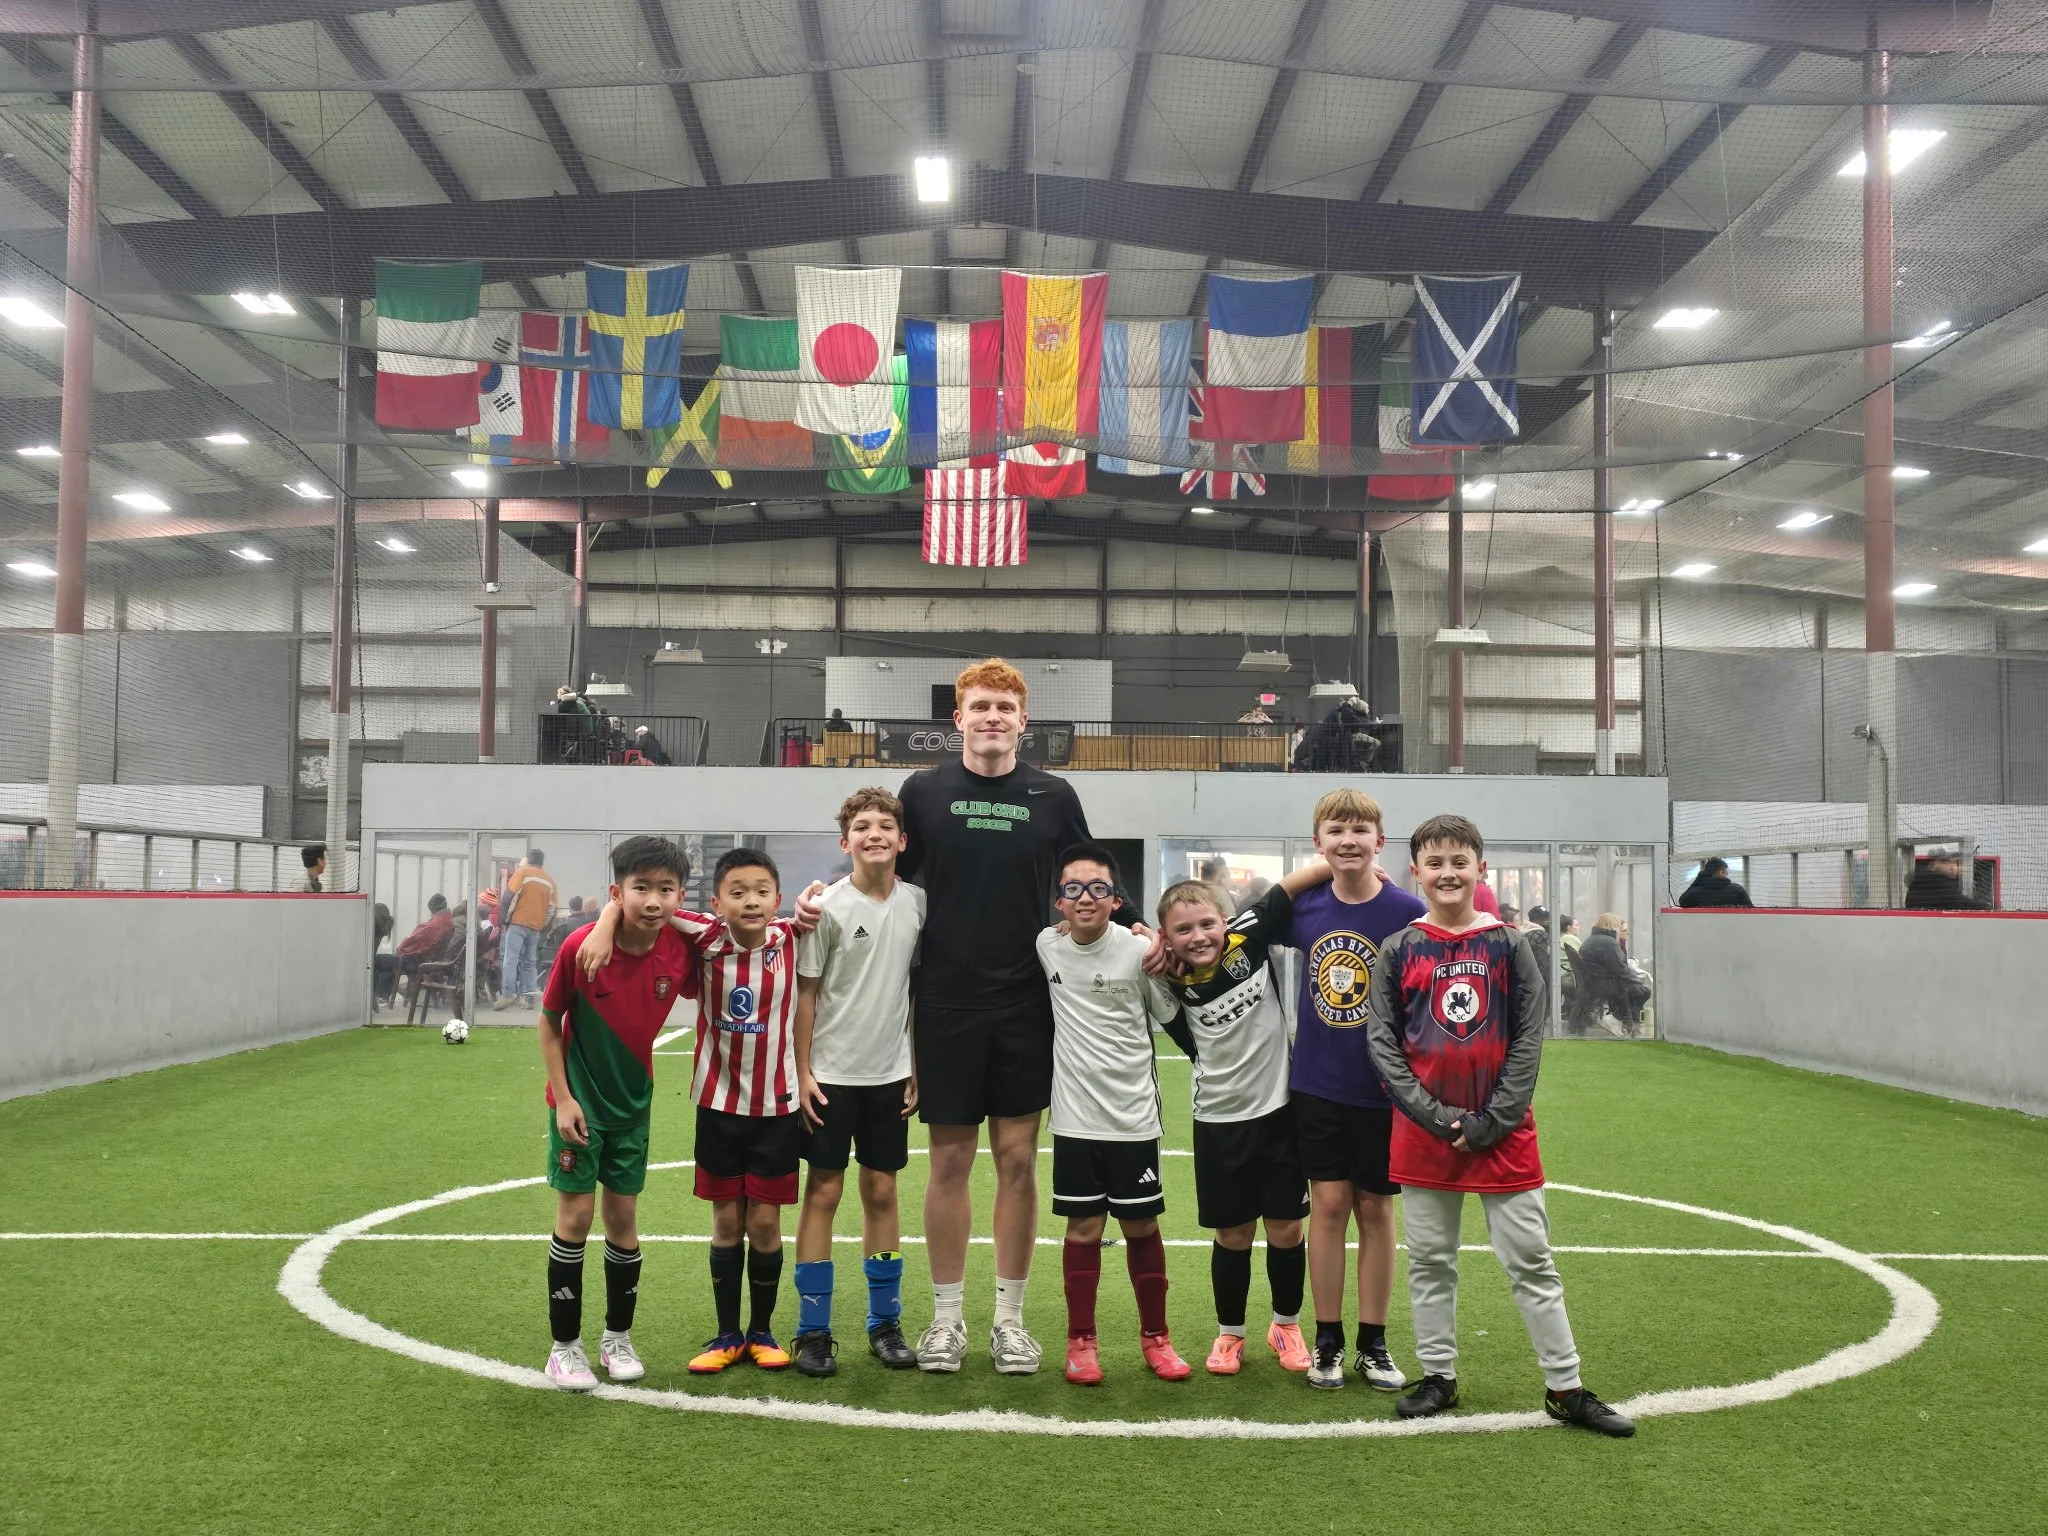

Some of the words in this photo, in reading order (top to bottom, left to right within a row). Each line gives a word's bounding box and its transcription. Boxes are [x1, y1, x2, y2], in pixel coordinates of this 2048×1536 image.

[908, 731, 1034, 752] coer
[950, 800, 992, 816] CLUB
[991, 802, 1030, 821] OHIO
[966, 817, 1013, 832] SOCCER
[1311, 937, 1345, 983] SCHELLAS
[1347, 939, 1377, 974] HYND
[1449, 962, 1486, 977] UNITED
[1314, 992, 1342, 1021] SOCCER
[1456, 1013, 1467, 1021] SC
[715, 1020, 747, 1032] RIYADH
[749, 1023, 765, 1033] AIR
